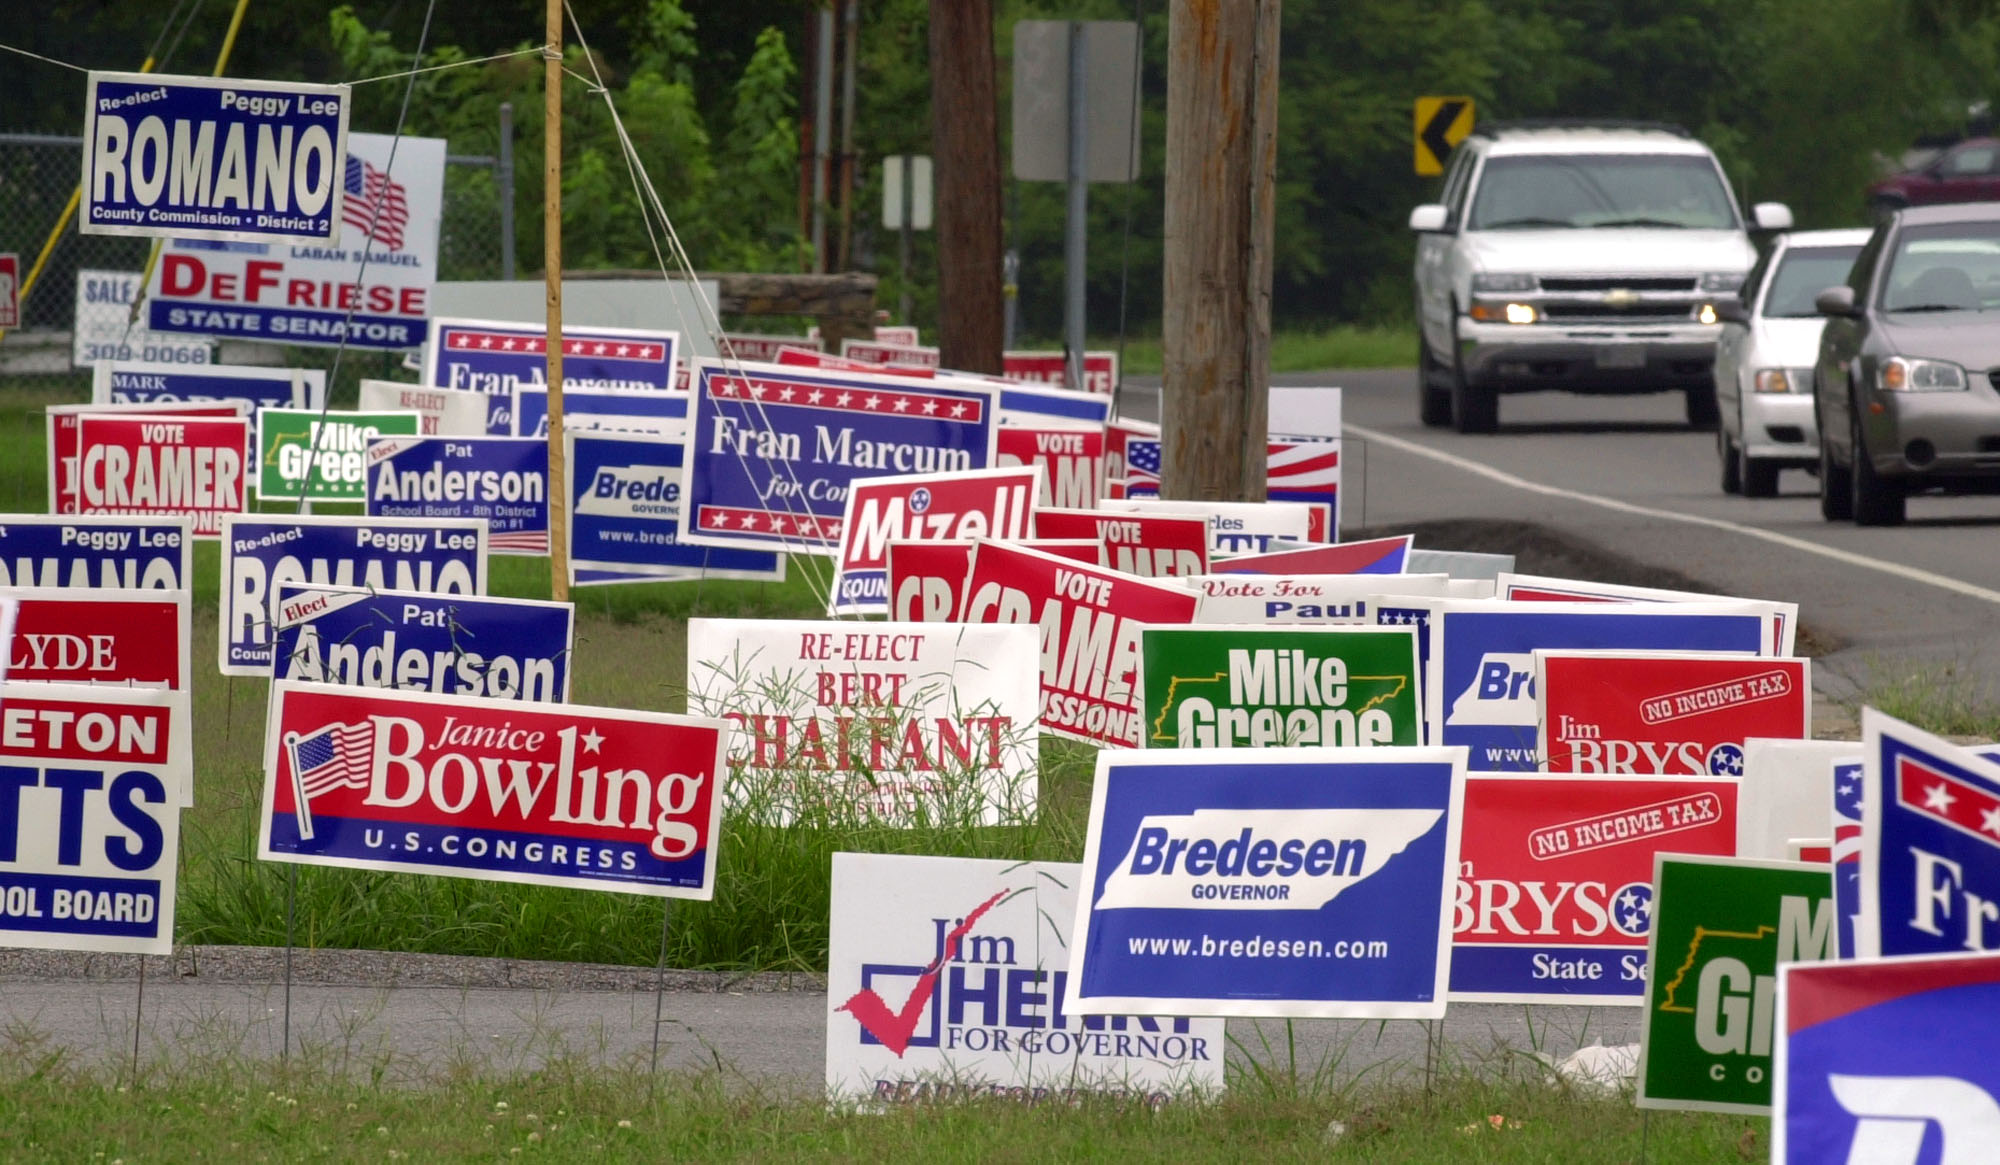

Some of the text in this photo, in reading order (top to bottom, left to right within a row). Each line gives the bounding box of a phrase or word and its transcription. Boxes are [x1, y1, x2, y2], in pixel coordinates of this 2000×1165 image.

[100, 87, 168, 112] Re-elect
[220, 90, 339, 117] Peggy Lee
[94, 115, 334, 216] ROMANO
[92, 206, 329, 232] County Commission District 2
[291, 248, 421, 268] LABAN SAMUEL
[85, 279, 131, 304] SALE
[168, 308, 409, 342] STATE SENATOR
[112, 374, 167, 390] MARK
[449, 362, 518, 396] Fran
[400, 391, 446, 411] RE-ELECT
[141, 424, 185, 444] VOTE
[310, 421, 379, 451] Mike
[709, 415, 801, 461] Fran
[812, 425, 972, 473] Marcum
[1036, 432, 1084, 454] VOTE
[279, 443, 366, 483] Gree
[445, 444, 473, 457] Pat
[84, 444, 240, 509] CRAMER
[375, 461, 543, 502] Anderson
[594, 473, 682, 501] Brede
[764, 474, 802, 500] for
[381, 505, 422, 517] School
[426, 505, 460, 517] Board
[473, 505, 491, 517] 8th
[495, 506, 536, 518] District
[850, 485, 1026, 562] Mizell
[61, 527, 180, 550] Peggy Lee
[234, 527, 303, 553] Re-elect
[356, 528, 477, 552] Peggy Lee
[1096, 520, 1141, 544] VOTE
[1054, 568, 1114, 608] VOTE
[1202, 580, 1324, 597] Vote For
[285, 596, 328, 622] Elect
[403, 604, 445, 628] Pat
[1265, 601, 1366, 618] Paul
[799, 633, 925, 662] RE-ELECT
[285, 624, 555, 701] Anderson
[816, 672, 907, 707] BERT
[1229, 649, 1347, 707] Mike
[1646, 675, 1786, 722] NO INCOME TAX
[429, 716, 544, 752] Janice
[1178, 697, 1393, 747] Greene
[1556, 715, 1601, 742] Jim
[363, 715, 704, 858] Bowling
[1536, 798, 1715, 856] NO INCOME TAX
[1129, 827, 1367, 877] Bredesen
[1191, 884, 1290, 900] GOVERNOR
[53, 890, 155, 923] BOARD
[920, 918, 1017, 976] Jim
[1128, 935, 1389, 959] www.bredesen.com
[1532, 953, 1603, 980] State
[947, 1028, 1210, 1062] FOR GOVERNOR
